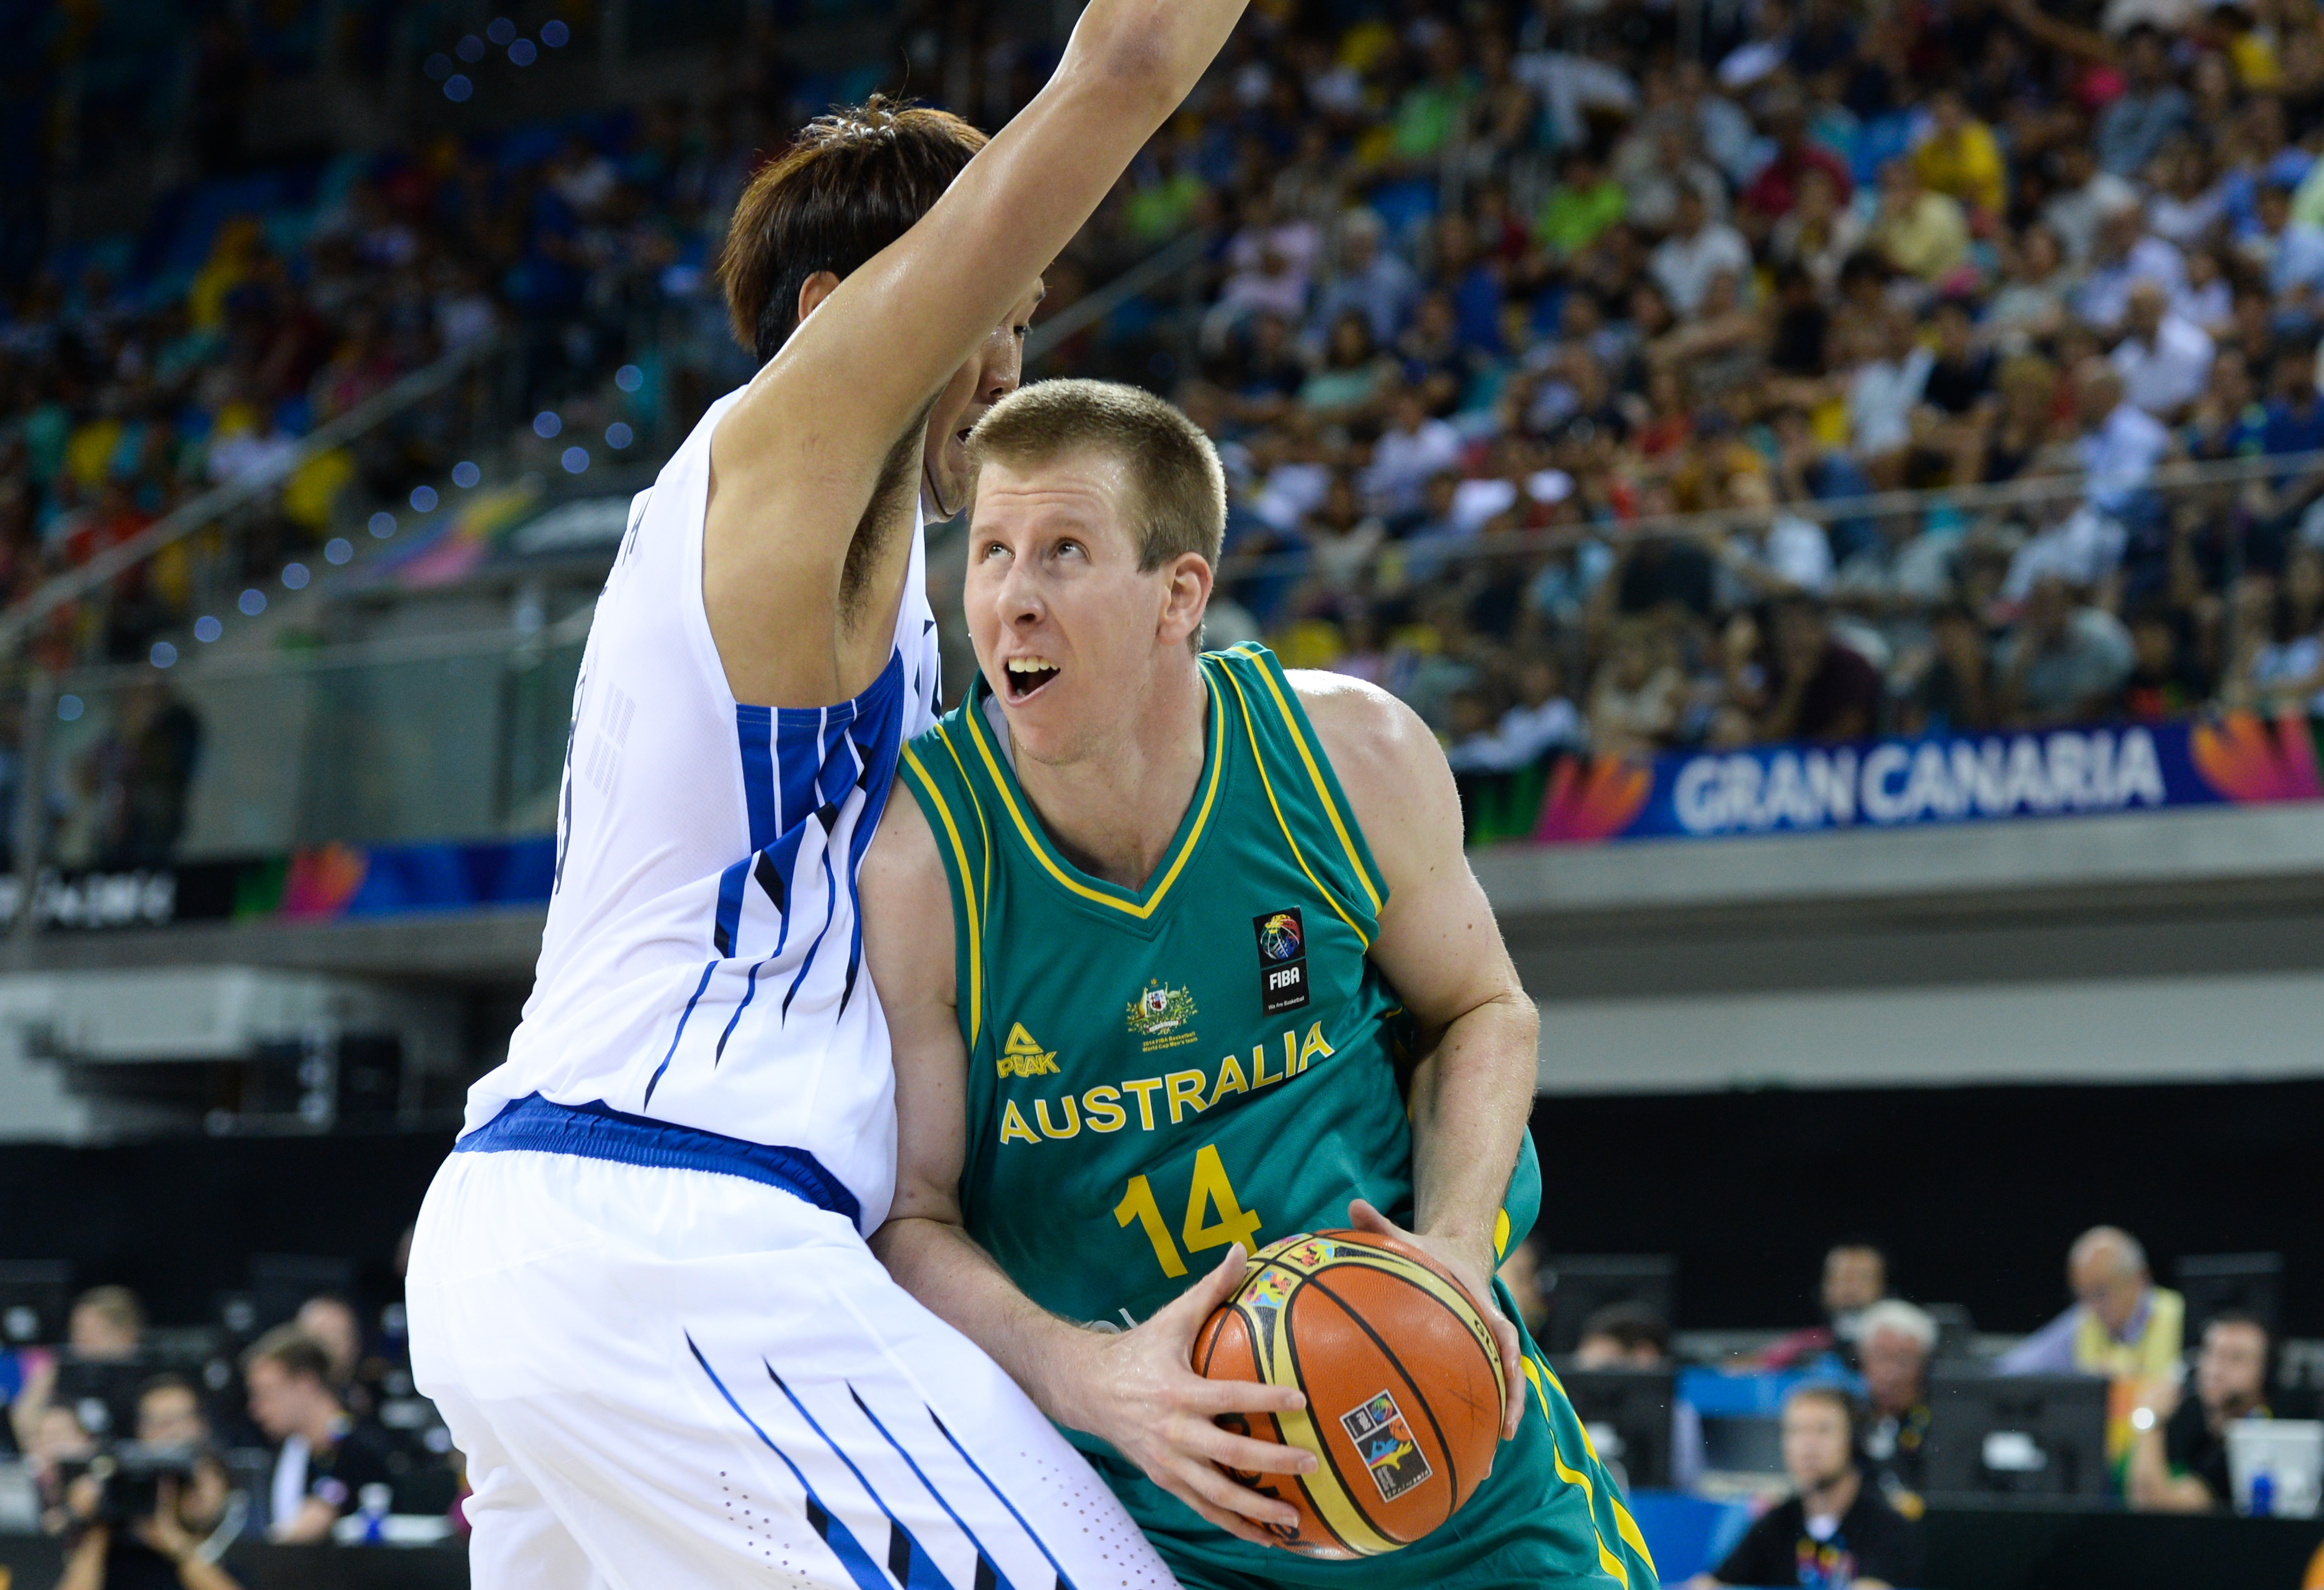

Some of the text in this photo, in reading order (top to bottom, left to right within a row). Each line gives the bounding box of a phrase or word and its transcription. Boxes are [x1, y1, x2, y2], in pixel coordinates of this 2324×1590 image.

[1673, 727, 2167, 835] GRAN CANARIA
[1269, 966, 1300, 990] FIBA
[997, 1051, 1060, 1078] PEAK
[1169, 1031, 1195, 1041] Basketball
[1000, 1021, 1335, 1145] AUSTRALIA
[1114, 1143, 1262, 1279] 14
